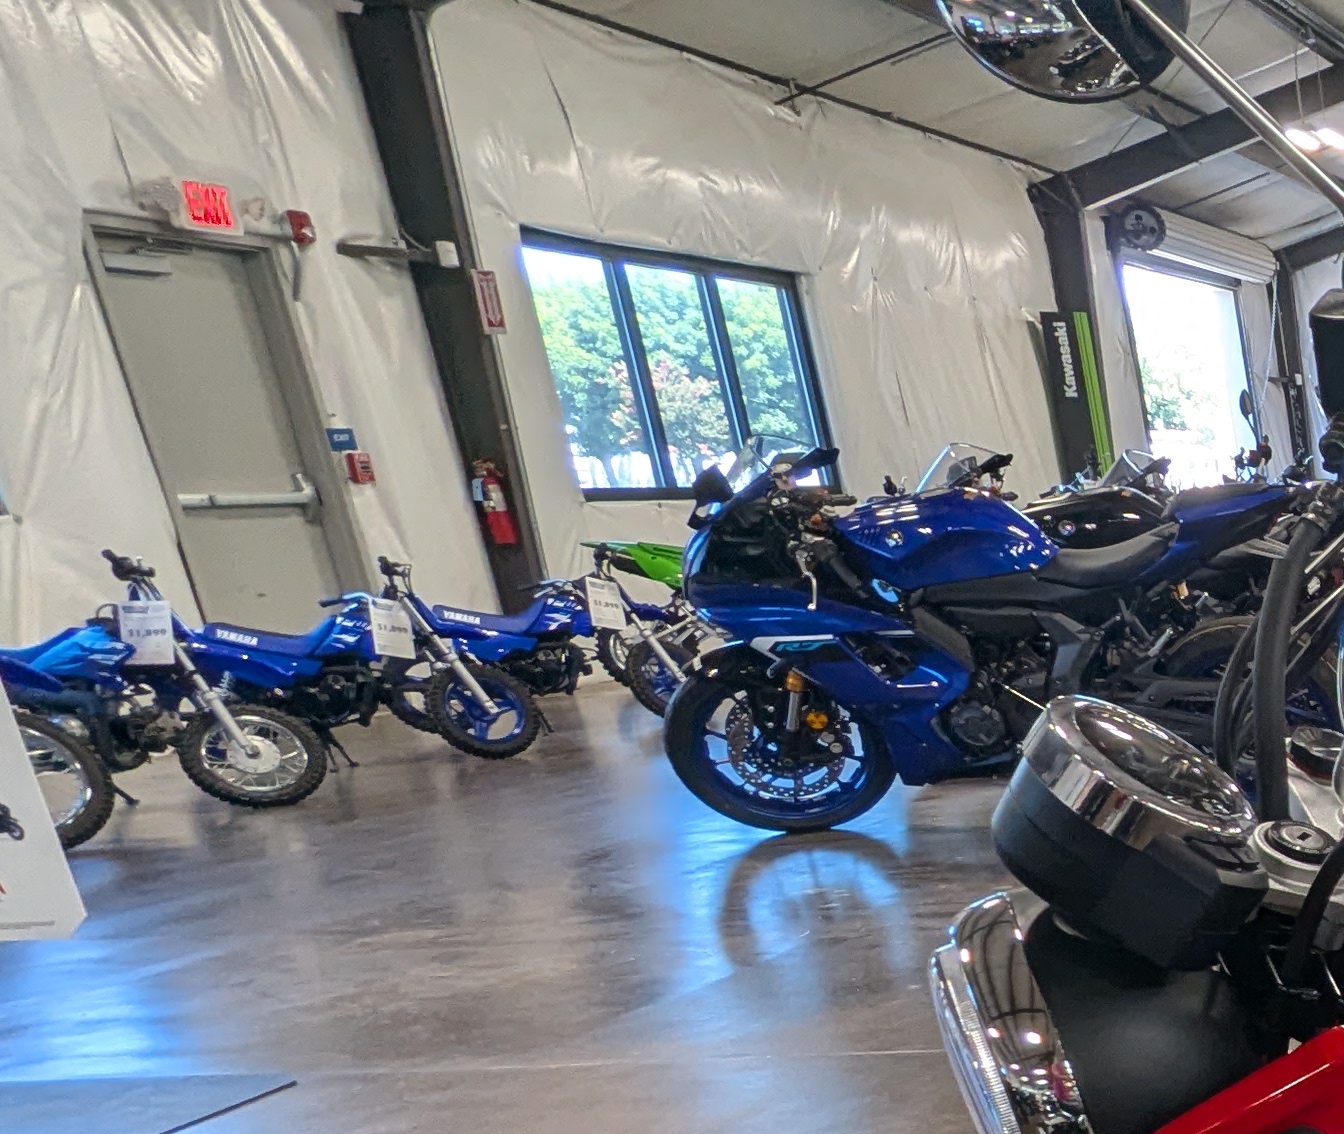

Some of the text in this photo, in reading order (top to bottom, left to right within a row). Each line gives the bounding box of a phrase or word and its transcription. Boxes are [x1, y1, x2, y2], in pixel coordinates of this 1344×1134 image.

[1052, 321, 1078, 397] Kawasaki
[443, 610, 481, 625] YAMAHA
[216, 628, 259, 647] YAMAHA
